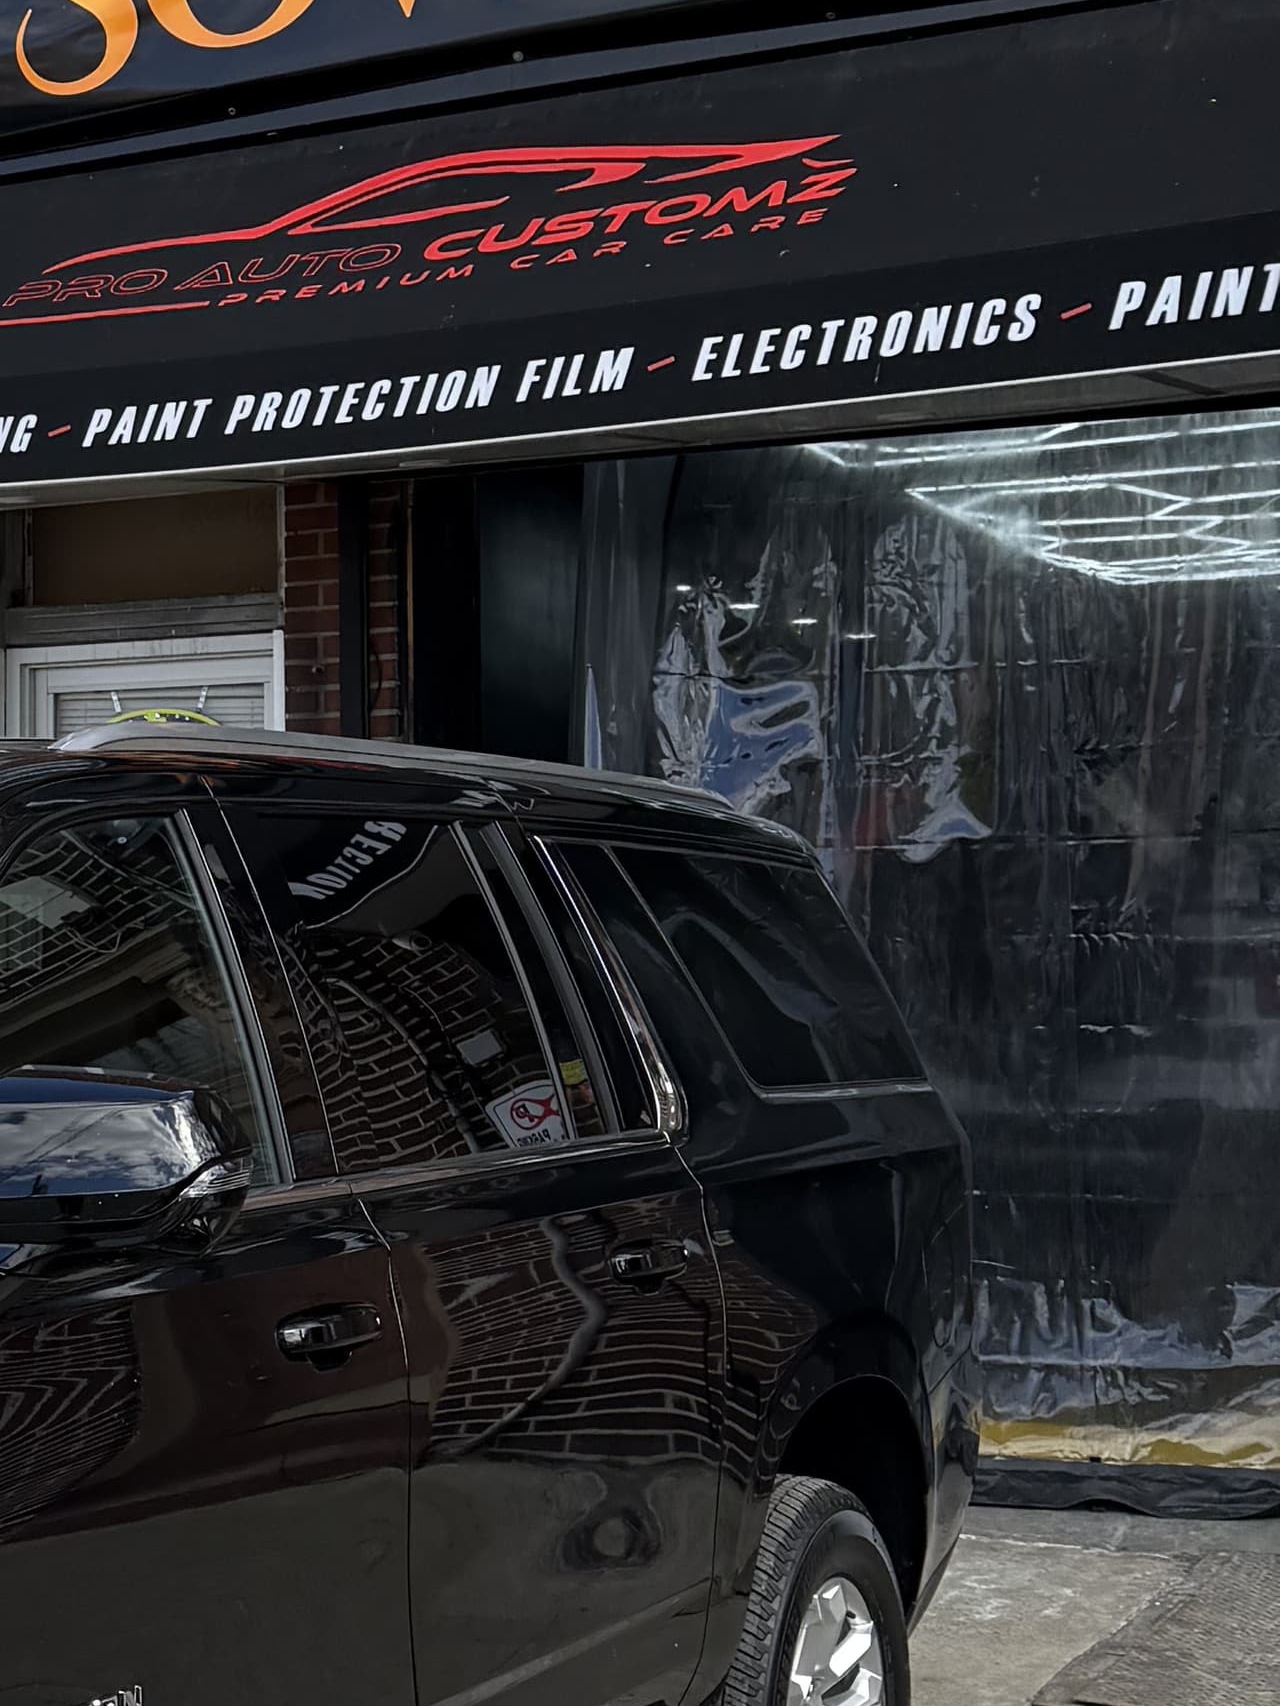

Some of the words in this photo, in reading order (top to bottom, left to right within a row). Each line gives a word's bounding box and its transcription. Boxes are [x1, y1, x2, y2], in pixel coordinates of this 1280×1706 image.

[2, 266, 168, 308] PRO
[173, 241, 402, 292] AUTO
[217, 263, 475, 307] PREMIUM
[510, 239, 628, 271] CAR
[663, 207, 828, 245] CARE
[82, 398, 212, 448] PAINT
[224, 364, 500, 435] PROTECTION
[515, 347, 635, 403] FILM
[692, 293, 1042, 382] ELECTRONICS
